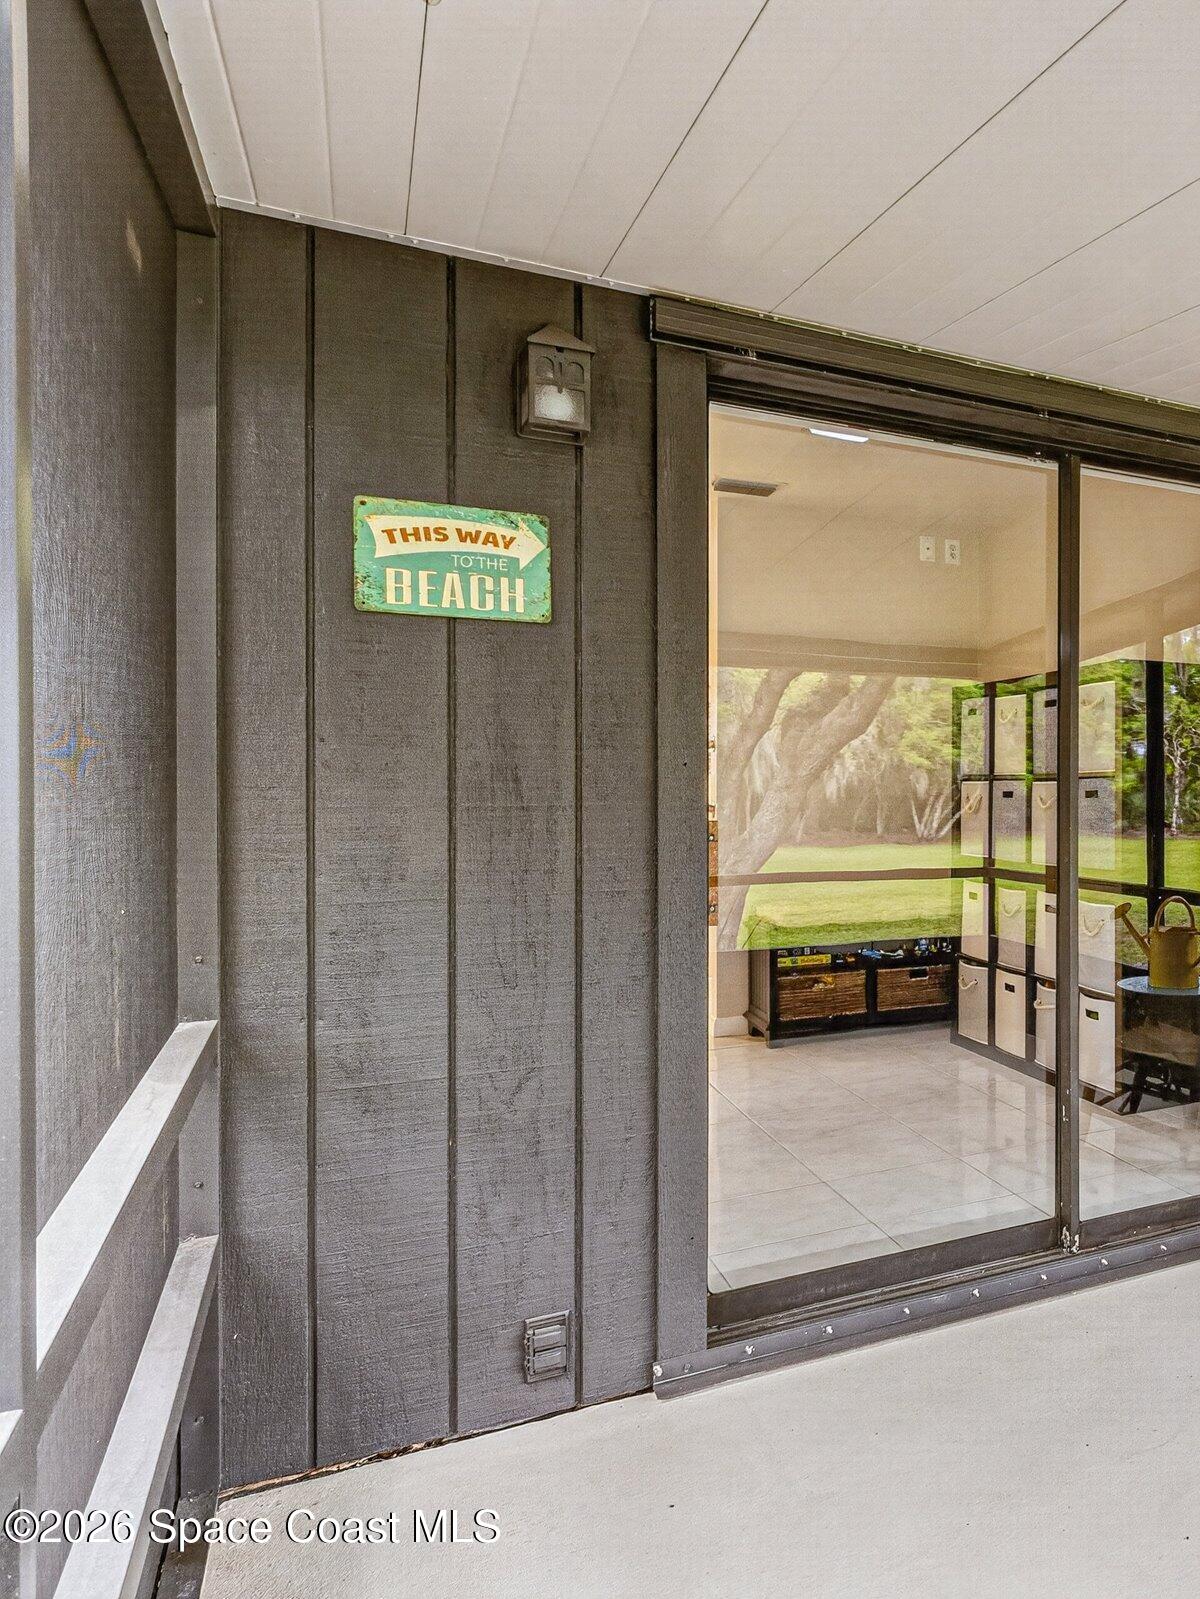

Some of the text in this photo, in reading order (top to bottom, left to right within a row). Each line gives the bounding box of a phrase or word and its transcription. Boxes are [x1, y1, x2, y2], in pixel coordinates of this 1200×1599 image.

[381, 526, 517, 550] THIS WAY
[451, 554, 508, 571] TO THE
[385, 567, 525, 613] BEACH
